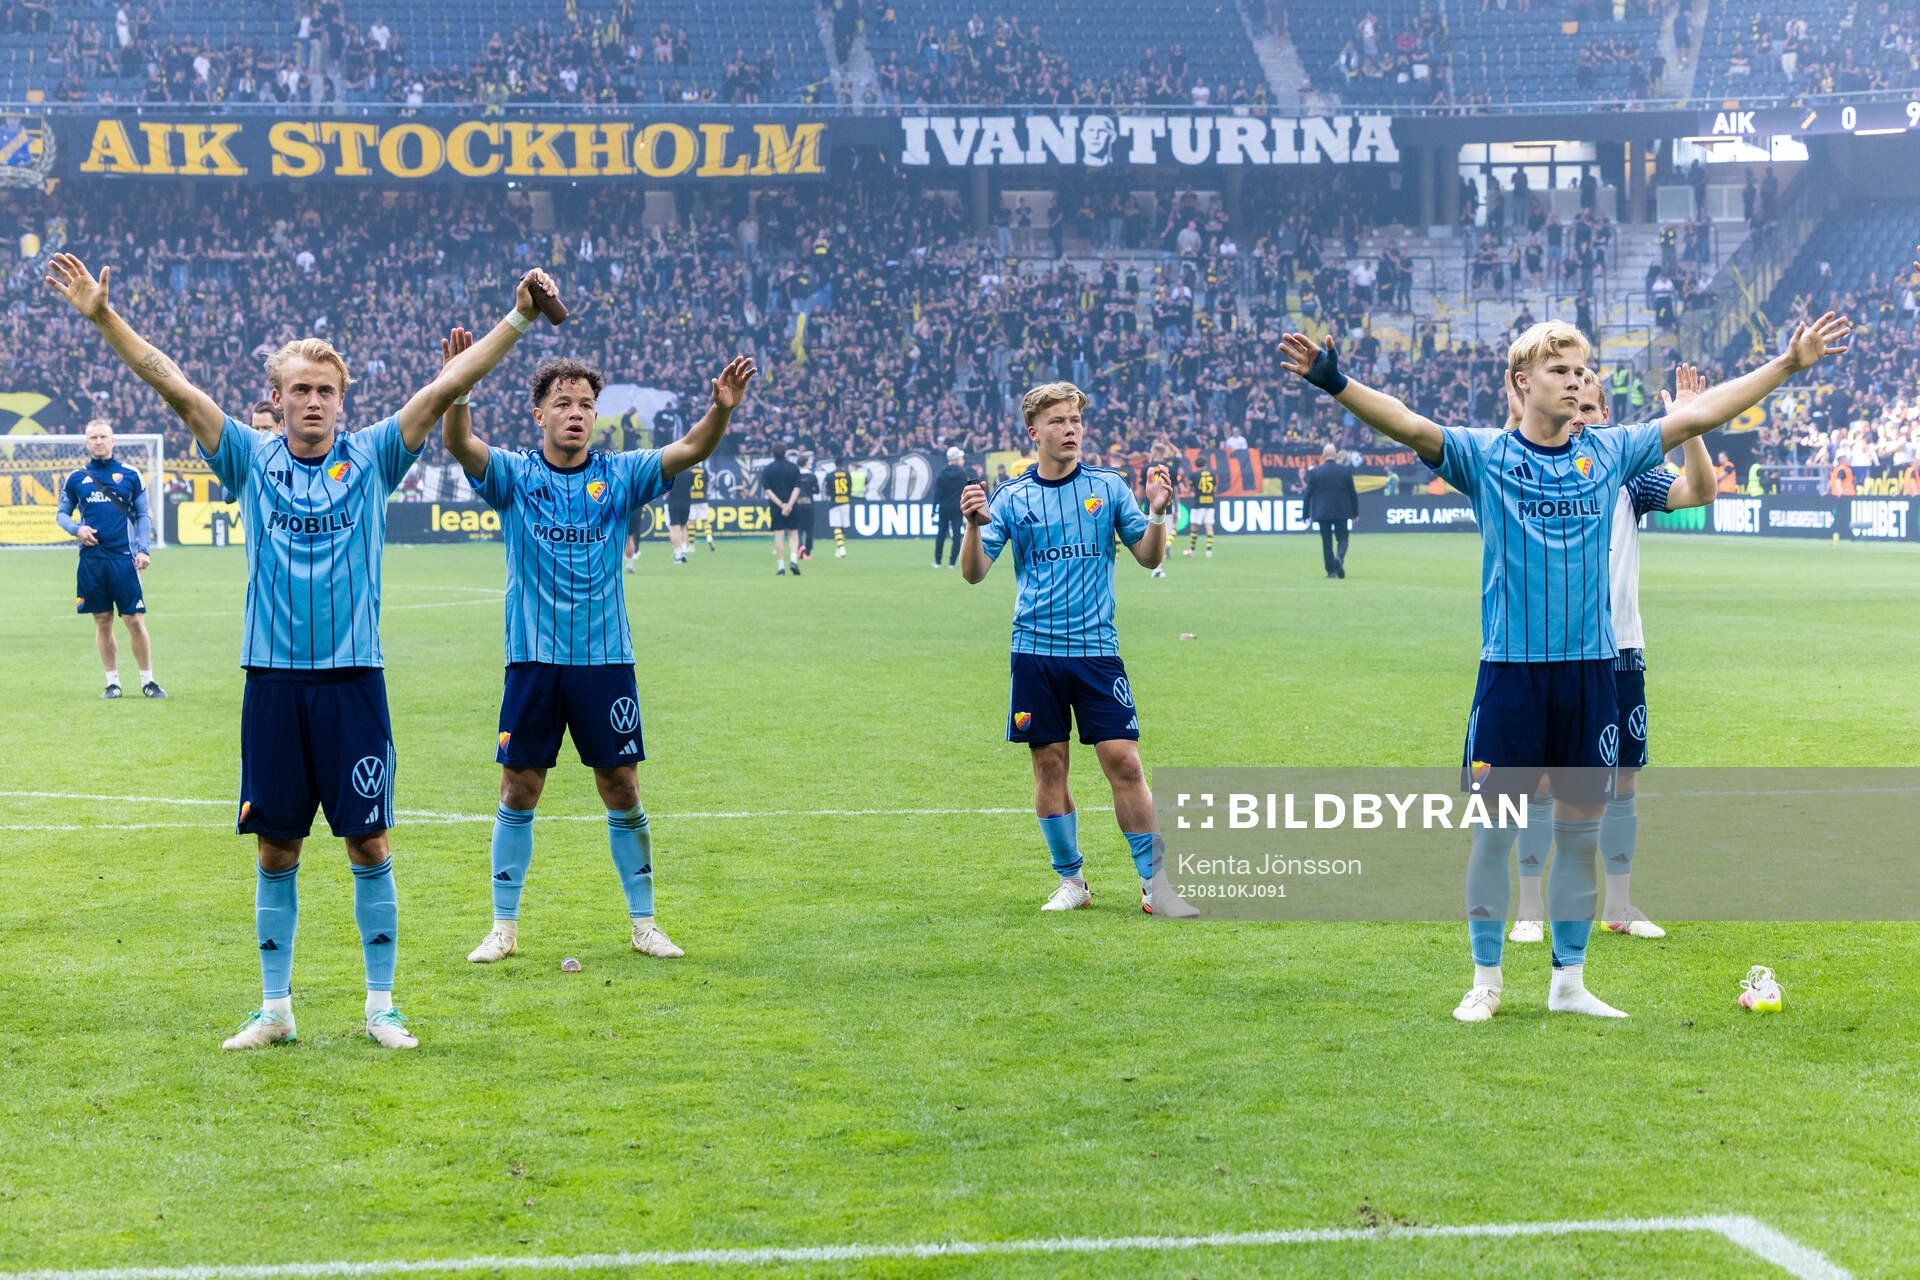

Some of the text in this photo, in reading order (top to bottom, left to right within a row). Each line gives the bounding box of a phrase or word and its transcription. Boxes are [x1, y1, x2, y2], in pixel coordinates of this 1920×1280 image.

[1712, 112, 1756, 134] AIK
[1842, 106, 1856, 129] 0
[80, 119, 827, 178] AIK STOCKHOLM
[902, 115, 1400, 166] IVAN TURINA
[1387, 508, 1430, 524] SPELA
[1517, 498, 1601, 520] MOBILL
[1713, 498, 1762, 532] UNIBET
[1850, 500, 1909, 537] UNIBET
[267, 510, 355, 534] MOBILL
[533, 523, 608, 544] MOBILL
[1031, 543, 1101, 567] MOBILL
[610, 697, 638, 733] VW
[352, 756, 385, 798] VW
